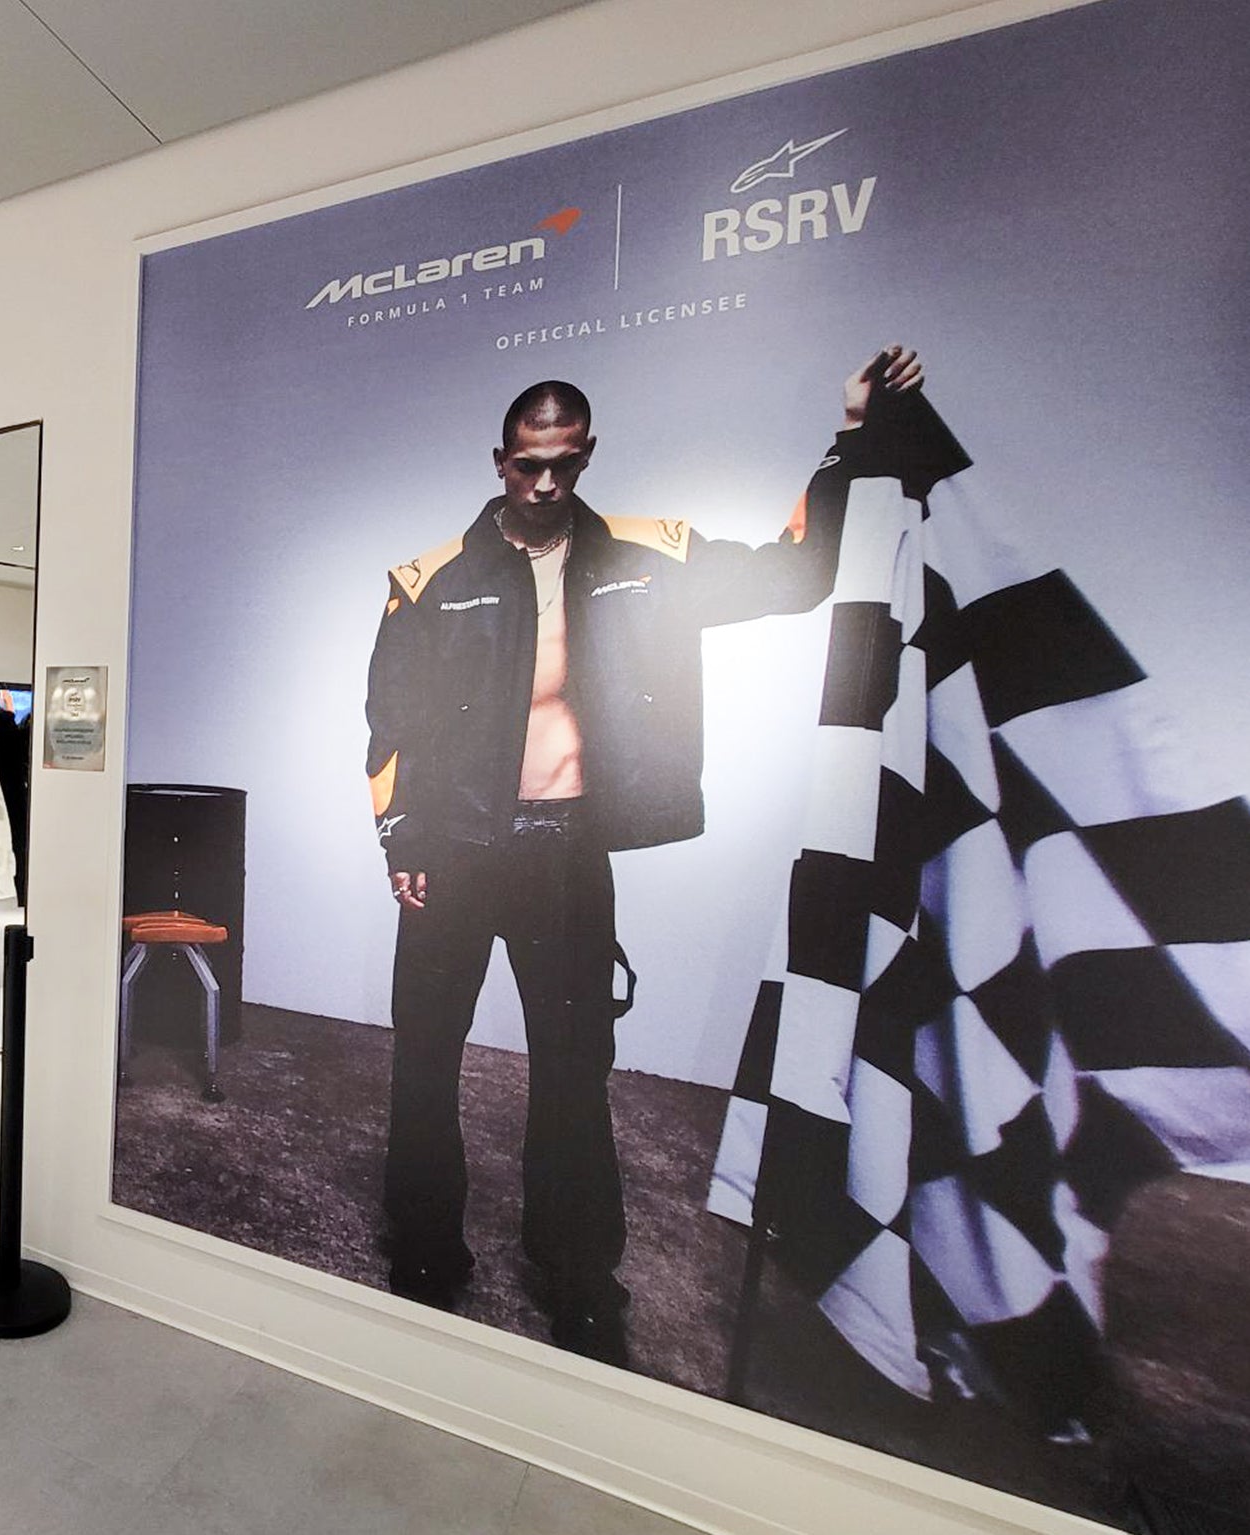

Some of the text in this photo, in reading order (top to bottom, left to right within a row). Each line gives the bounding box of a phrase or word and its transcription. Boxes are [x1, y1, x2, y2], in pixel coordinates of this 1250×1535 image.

[702, 176, 877, 262] RSRV
[304, 237, 546, 310] McLaren
[346, 277, 544, 327] FORMULA 1 TEAM
[495, 293, 747, 350] OFFICIAL LICENSEE
